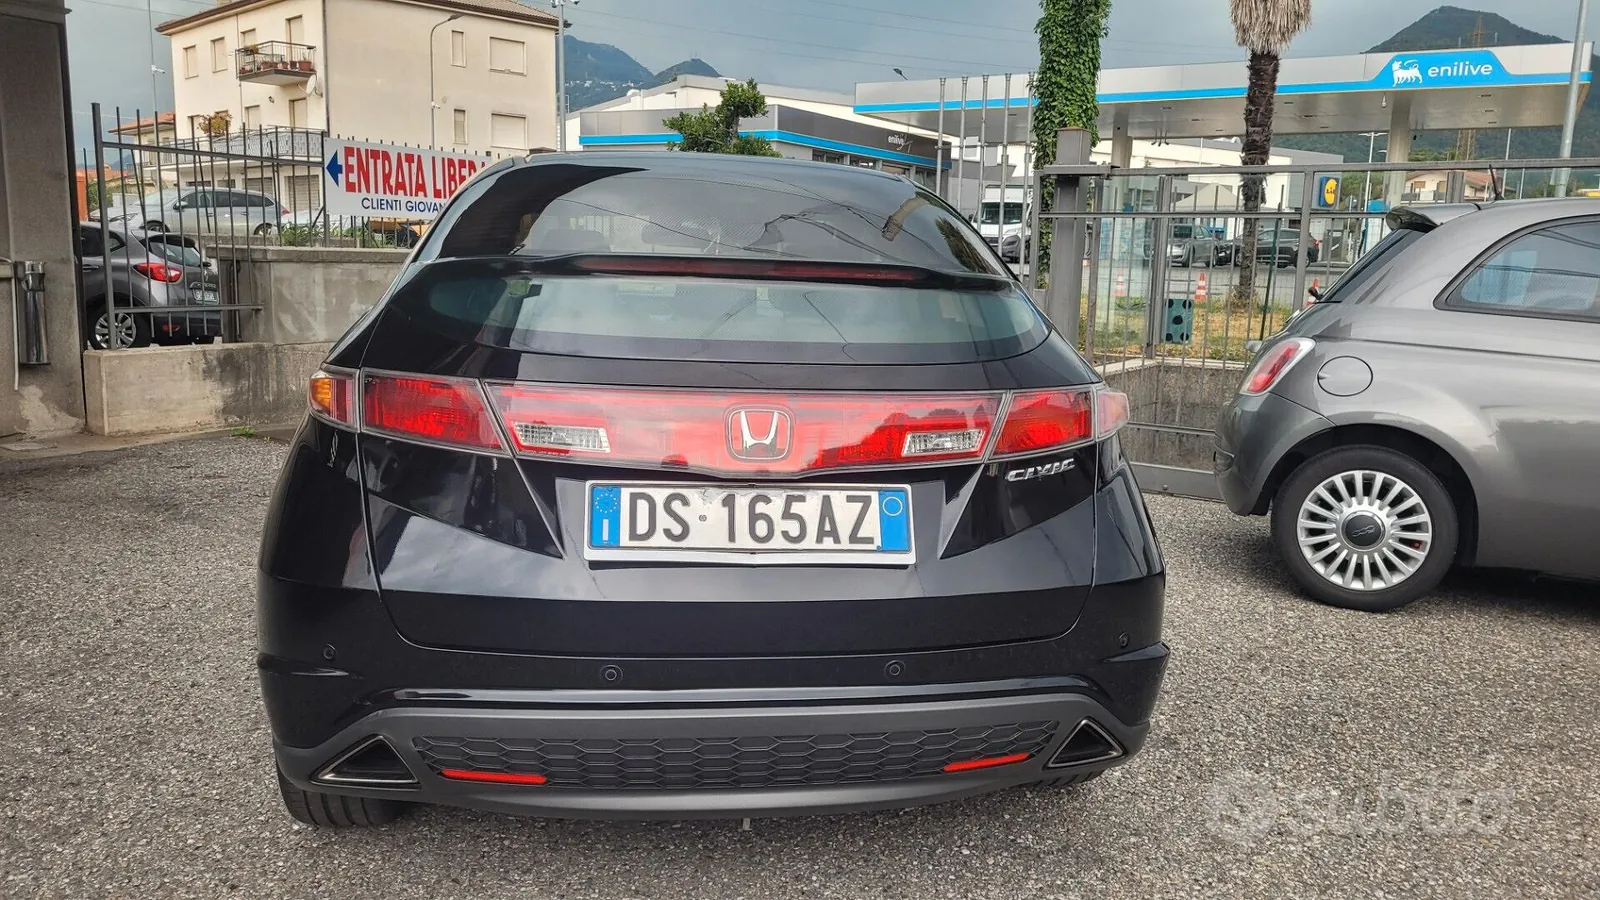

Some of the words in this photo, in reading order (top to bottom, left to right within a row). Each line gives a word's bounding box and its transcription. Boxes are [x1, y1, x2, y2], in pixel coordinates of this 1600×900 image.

[1427, 61, 1493, 77] enilive
[343, 145, 428, 198] ENTRATA
[431, 155, 486, 200] LIBE
[361, 197, 402, 212] CLIENTI
[1005, 458, 1075, 482] CIVIC
[628, 492, 691, 543] DS
[721, 493, 875, 545] 165AZ
